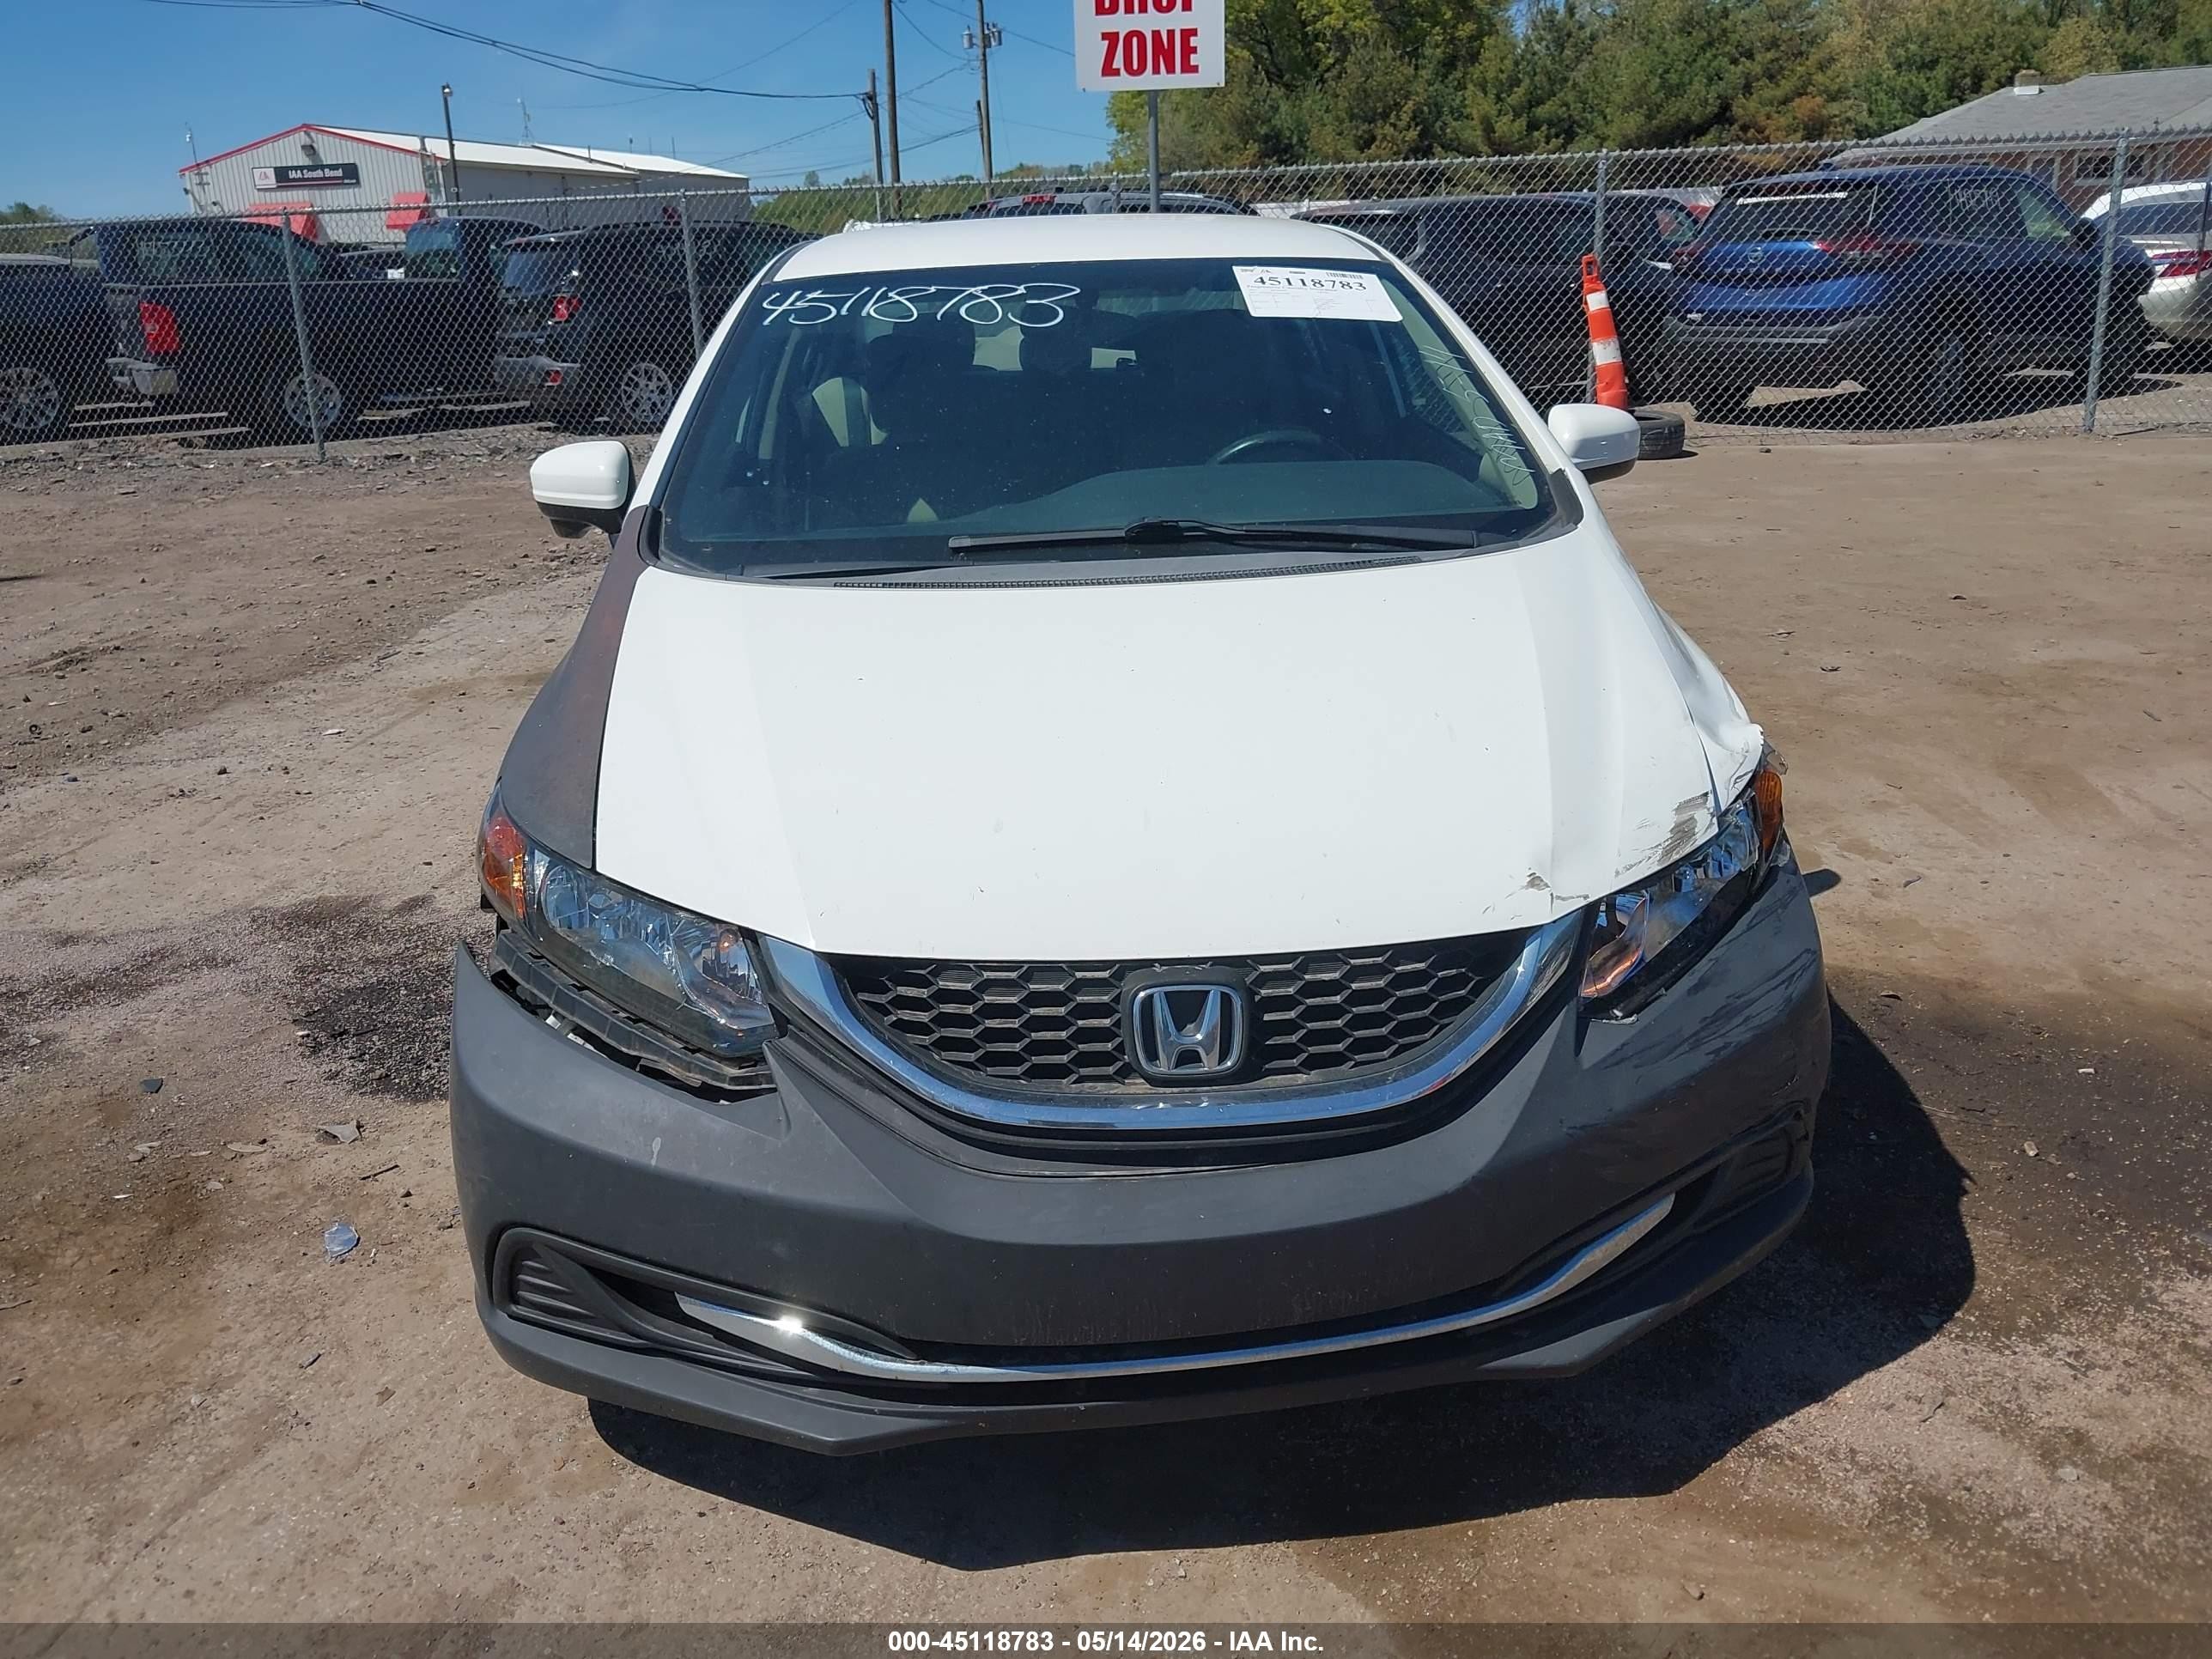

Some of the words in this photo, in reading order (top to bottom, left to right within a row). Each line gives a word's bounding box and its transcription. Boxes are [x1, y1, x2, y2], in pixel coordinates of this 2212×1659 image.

[1100, 27, 1200, 77] ZONE
[762, 283, 1081, 327] 45118783
[1253, 276, 1368, 291] 45118783
